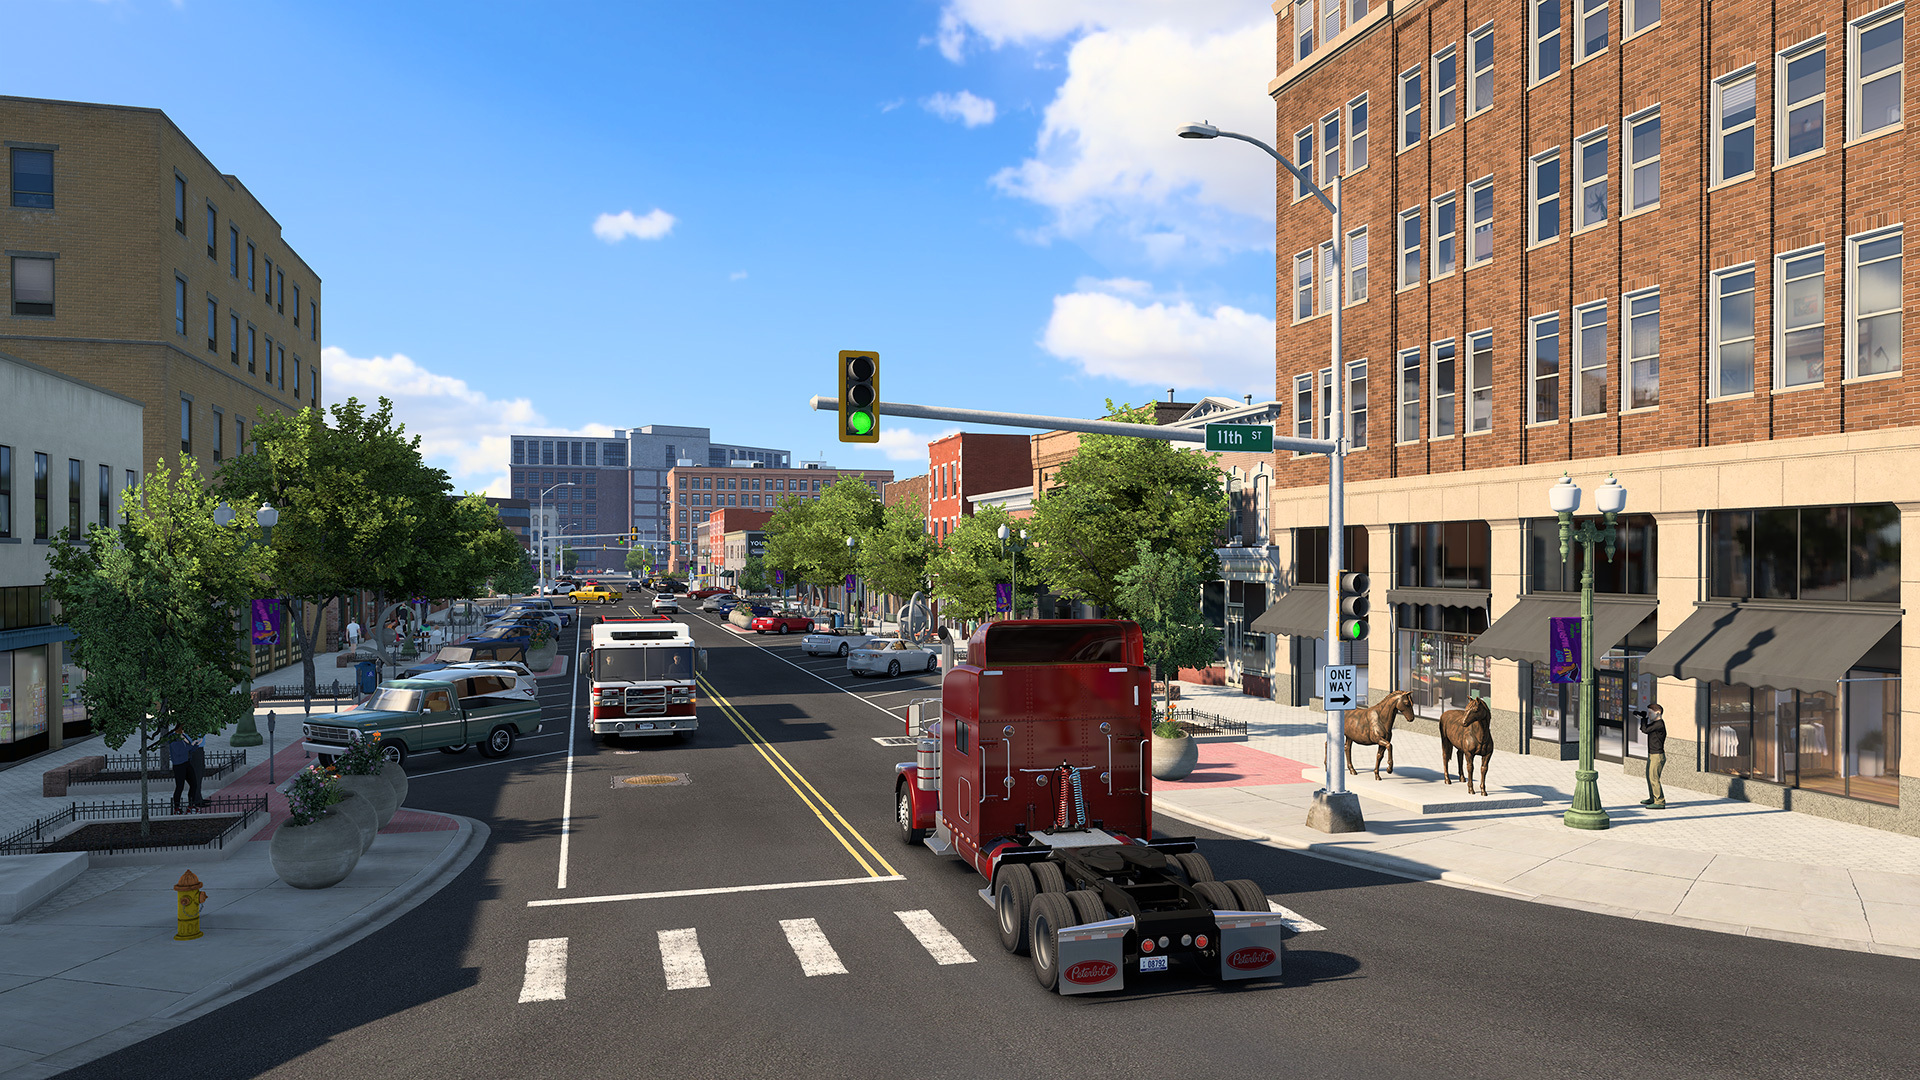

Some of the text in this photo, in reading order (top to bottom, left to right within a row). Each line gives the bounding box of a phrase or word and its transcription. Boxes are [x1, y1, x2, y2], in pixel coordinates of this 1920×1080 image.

[1217, 430, 1262, 445] 11th ST
[1330, 669, 1352, 680] ONE
[1329, 681, 1352, 692] WAY
[1232, 951, 1272, 966] Peterbilt
[1071, 964, 1113, 980] Peterbilt
